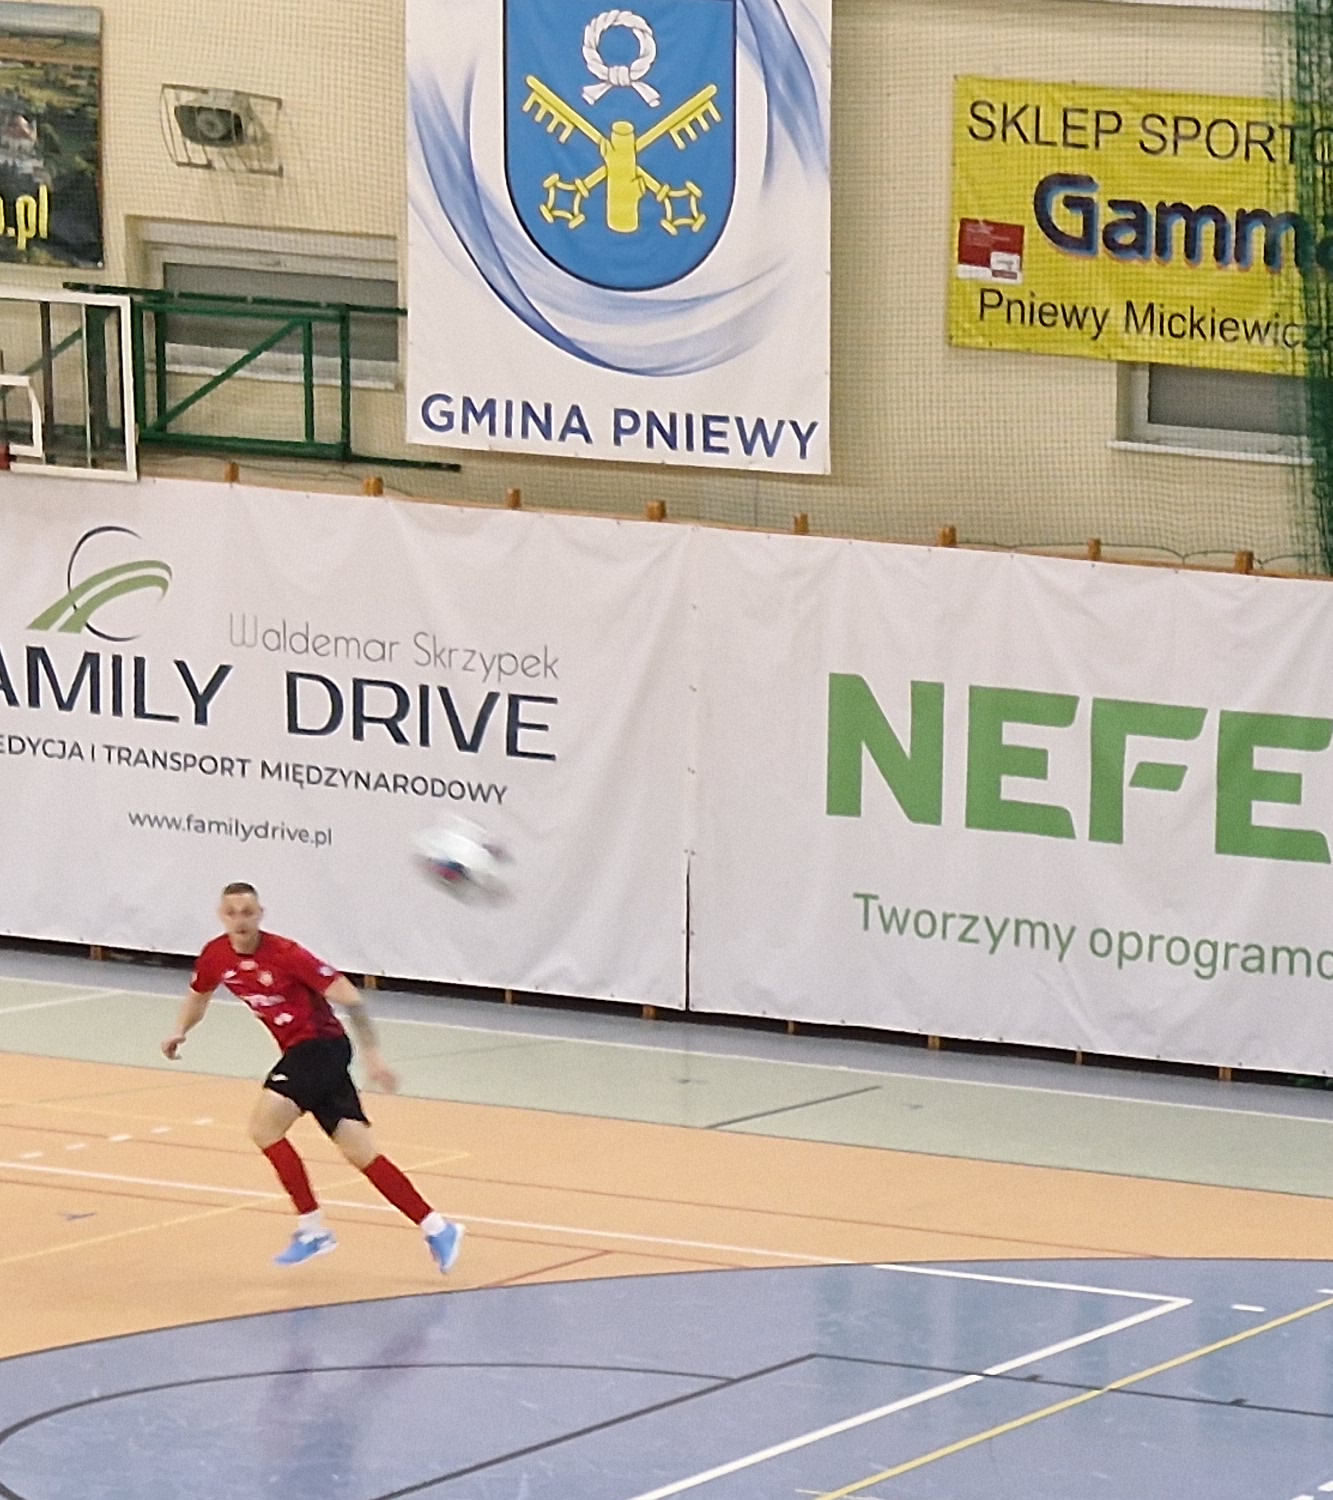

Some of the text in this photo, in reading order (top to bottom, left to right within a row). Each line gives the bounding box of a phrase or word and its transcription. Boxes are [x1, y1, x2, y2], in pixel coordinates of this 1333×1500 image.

[969, 101, 1123, 149] SKLEP
[978, 289, 1109, 335] Pniewy
[420, 394, 821, 461] GMINA PNIEWY
[228, 613, 559, 684] Waldemar Skrzypek
[285, 671, 559, 761] DRIVE
[92, 745, 95, 762] I
[103, 744, 252, 778] TRANSPORT
[260, 760, 509, 804] MIĘDZYNARODOWY
[128, 811, 333, 847] www.familydrive.pl
[853, 892, 1075, 962] Tworzymy
